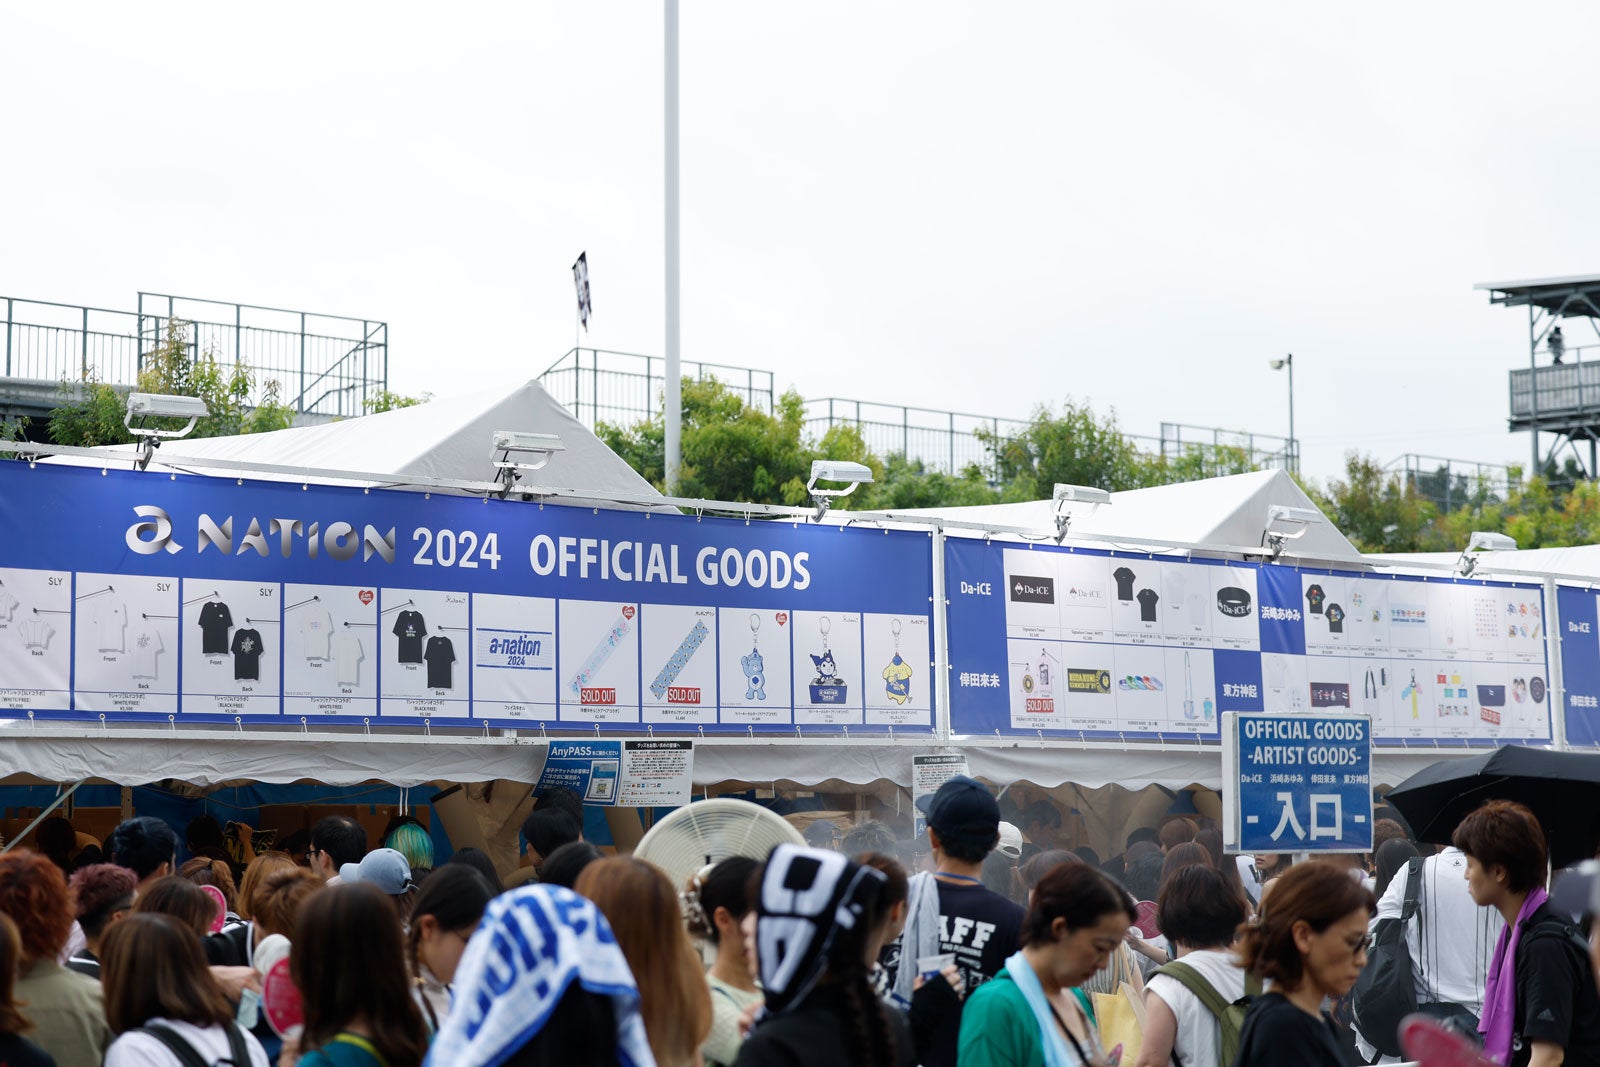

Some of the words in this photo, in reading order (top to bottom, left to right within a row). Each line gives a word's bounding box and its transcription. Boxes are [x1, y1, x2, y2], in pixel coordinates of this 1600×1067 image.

[198, 513, 396, 565] NATION
[413, 527, 502, 570] 2024
[530, 534, 688, 584] OFFICIAL
[696, 546, 811, 590] GOODS
[48, 577, 63, 586] SLY
[156, 583, 171, 592] SLY
[259, 588, 273, 597] SLY
[960, 581, 992, 596] Da-iCE
[1024, 584, 1049, 595] Da-iCE
[1078, 589, 1101, 598] Da-iCE
[1223, 604, 1246, 614] Da-iCE
[1261, 606, 1301, 621] 浜崎あゆみ
[489, 635, 541, 656] a-nation
[507, 656, 526, 666] 2024
[582, 689, 599, 702] SOLD
[601, 690, 616, 703] OUT
[668, 689, 686, 701] SOLD
[688, 690, 700, 702] OUT
[1223, 683, 1257, 698] 東方神起
[1027, 699, 1042, 711] SOLD
[1043, 700, 1054, 712] OUT
[1245, 720, 1311, 740] OFFICIAL
[1313, 722, 1363, 740] GOODS
[551, 746, 592, 757] AnyPASS
[1248, 746, 1304, 765] -ARTIST
[1307, 748, 1361, 765] GOODS-
[1241, 774, 1262, 784] Da-iCE
[1343, 775, 1369, 784] 東方神起
[1270, 792, 1343, 842] 入口
[939, 915, 997, 950] AFF
